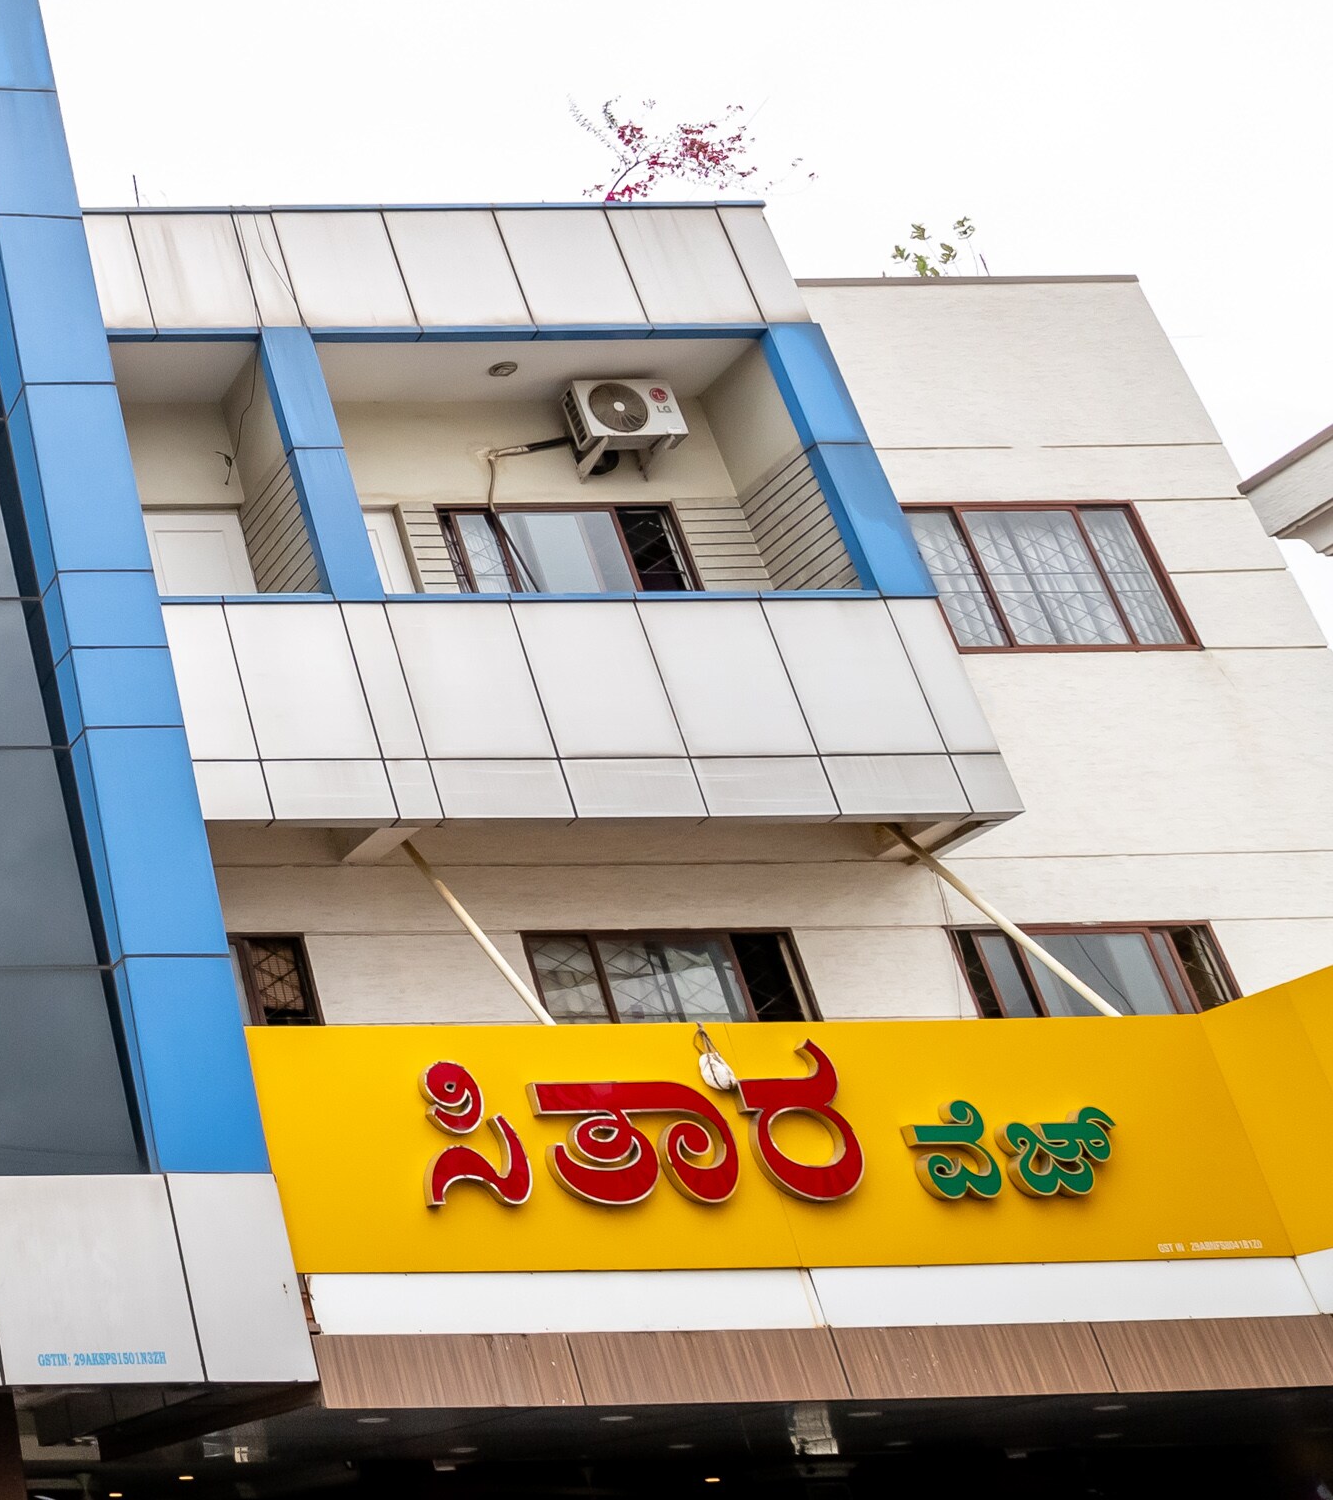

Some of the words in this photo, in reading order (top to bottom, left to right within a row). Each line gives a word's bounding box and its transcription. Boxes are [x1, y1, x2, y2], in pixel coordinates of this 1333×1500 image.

[655, 405, 673, 414] LG
[423, 1039, 865, 1208] ಸಿತಾರ
[901, 1100, 1117, 1202] ವೆಜ್
